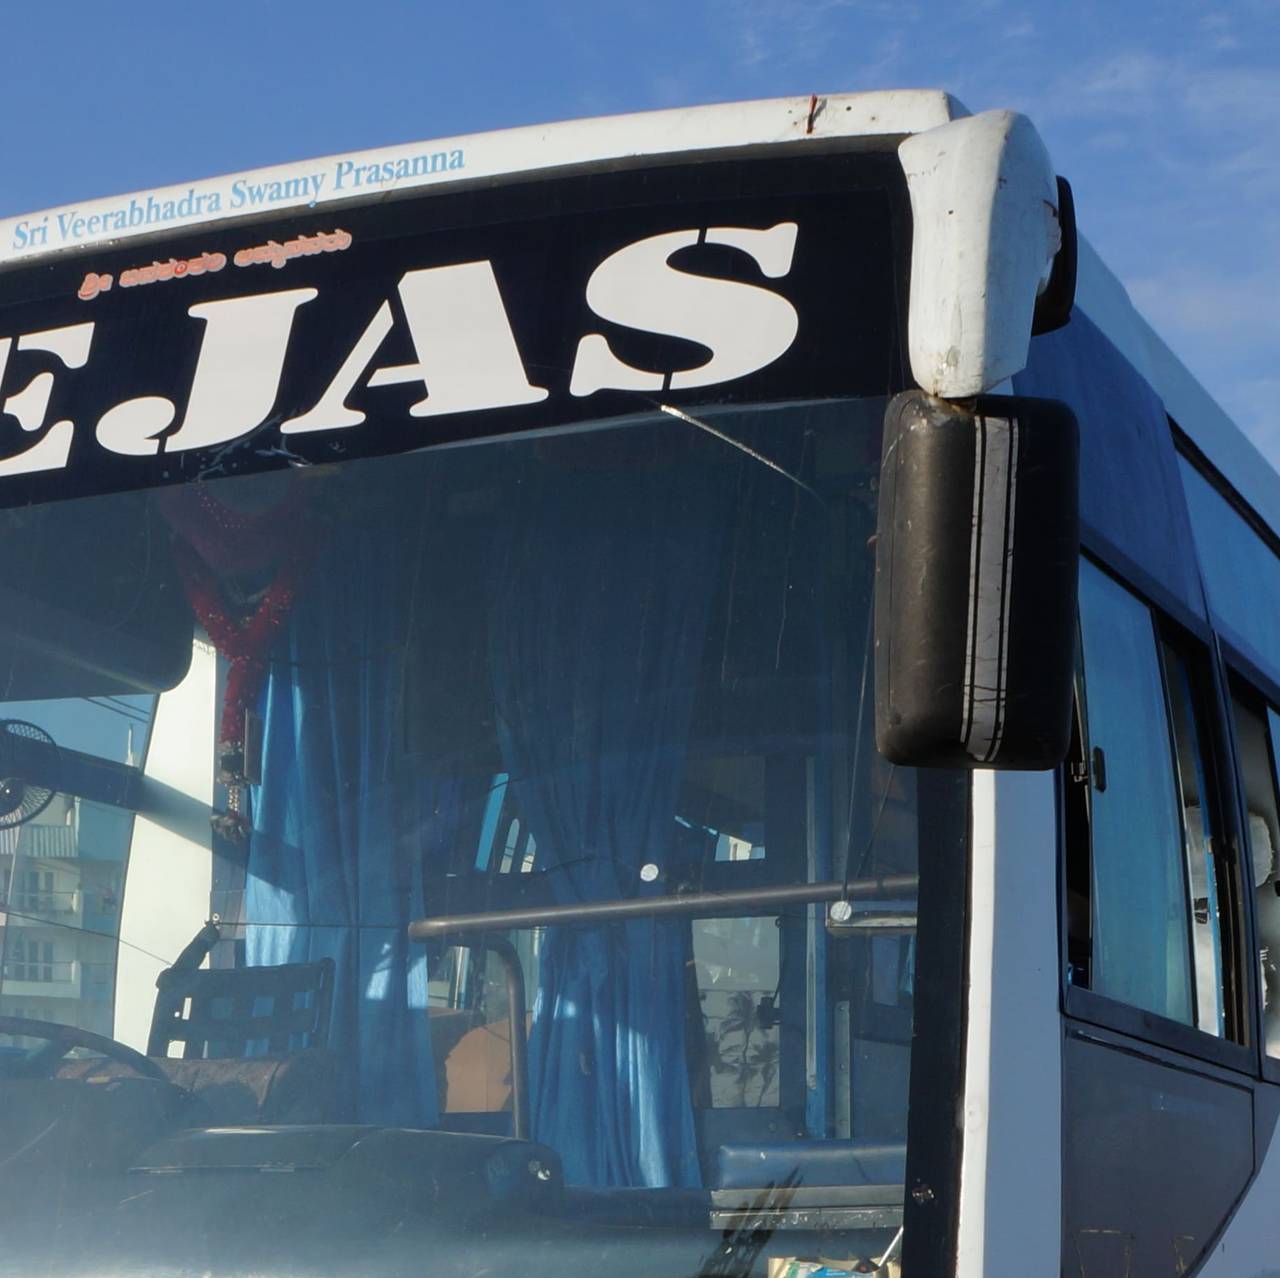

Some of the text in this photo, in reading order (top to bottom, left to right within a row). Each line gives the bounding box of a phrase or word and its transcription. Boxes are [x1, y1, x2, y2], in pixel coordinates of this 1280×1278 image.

[12, 147, 466, 251] Sri Veerabhadra Swamy Prasanna
